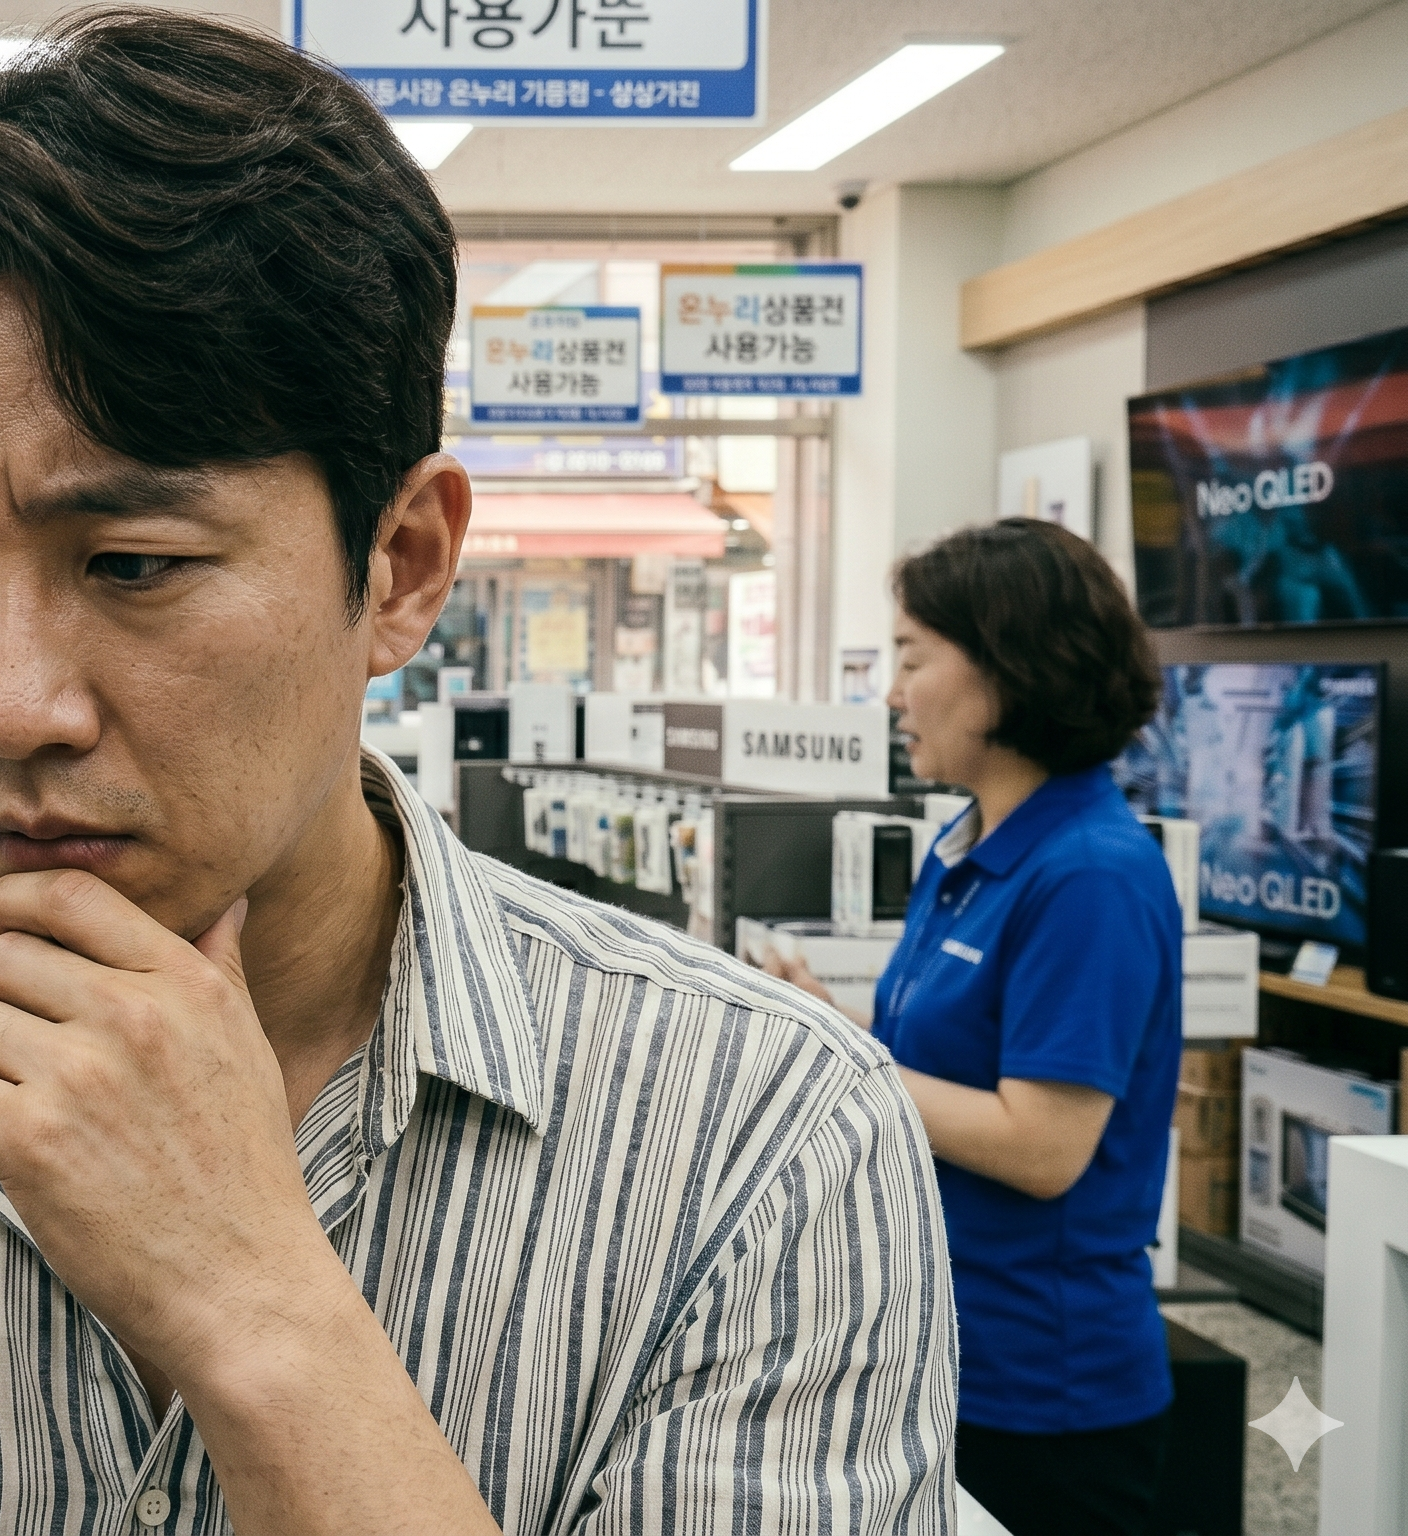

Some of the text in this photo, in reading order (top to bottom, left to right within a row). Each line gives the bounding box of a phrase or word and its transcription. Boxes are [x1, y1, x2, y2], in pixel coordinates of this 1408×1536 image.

[1196, 461, 1333, 518] Neo QLED
[744, 731, 862, 762] SAMSUNG
[1201, 861, 1341, 919] Neo QLED
